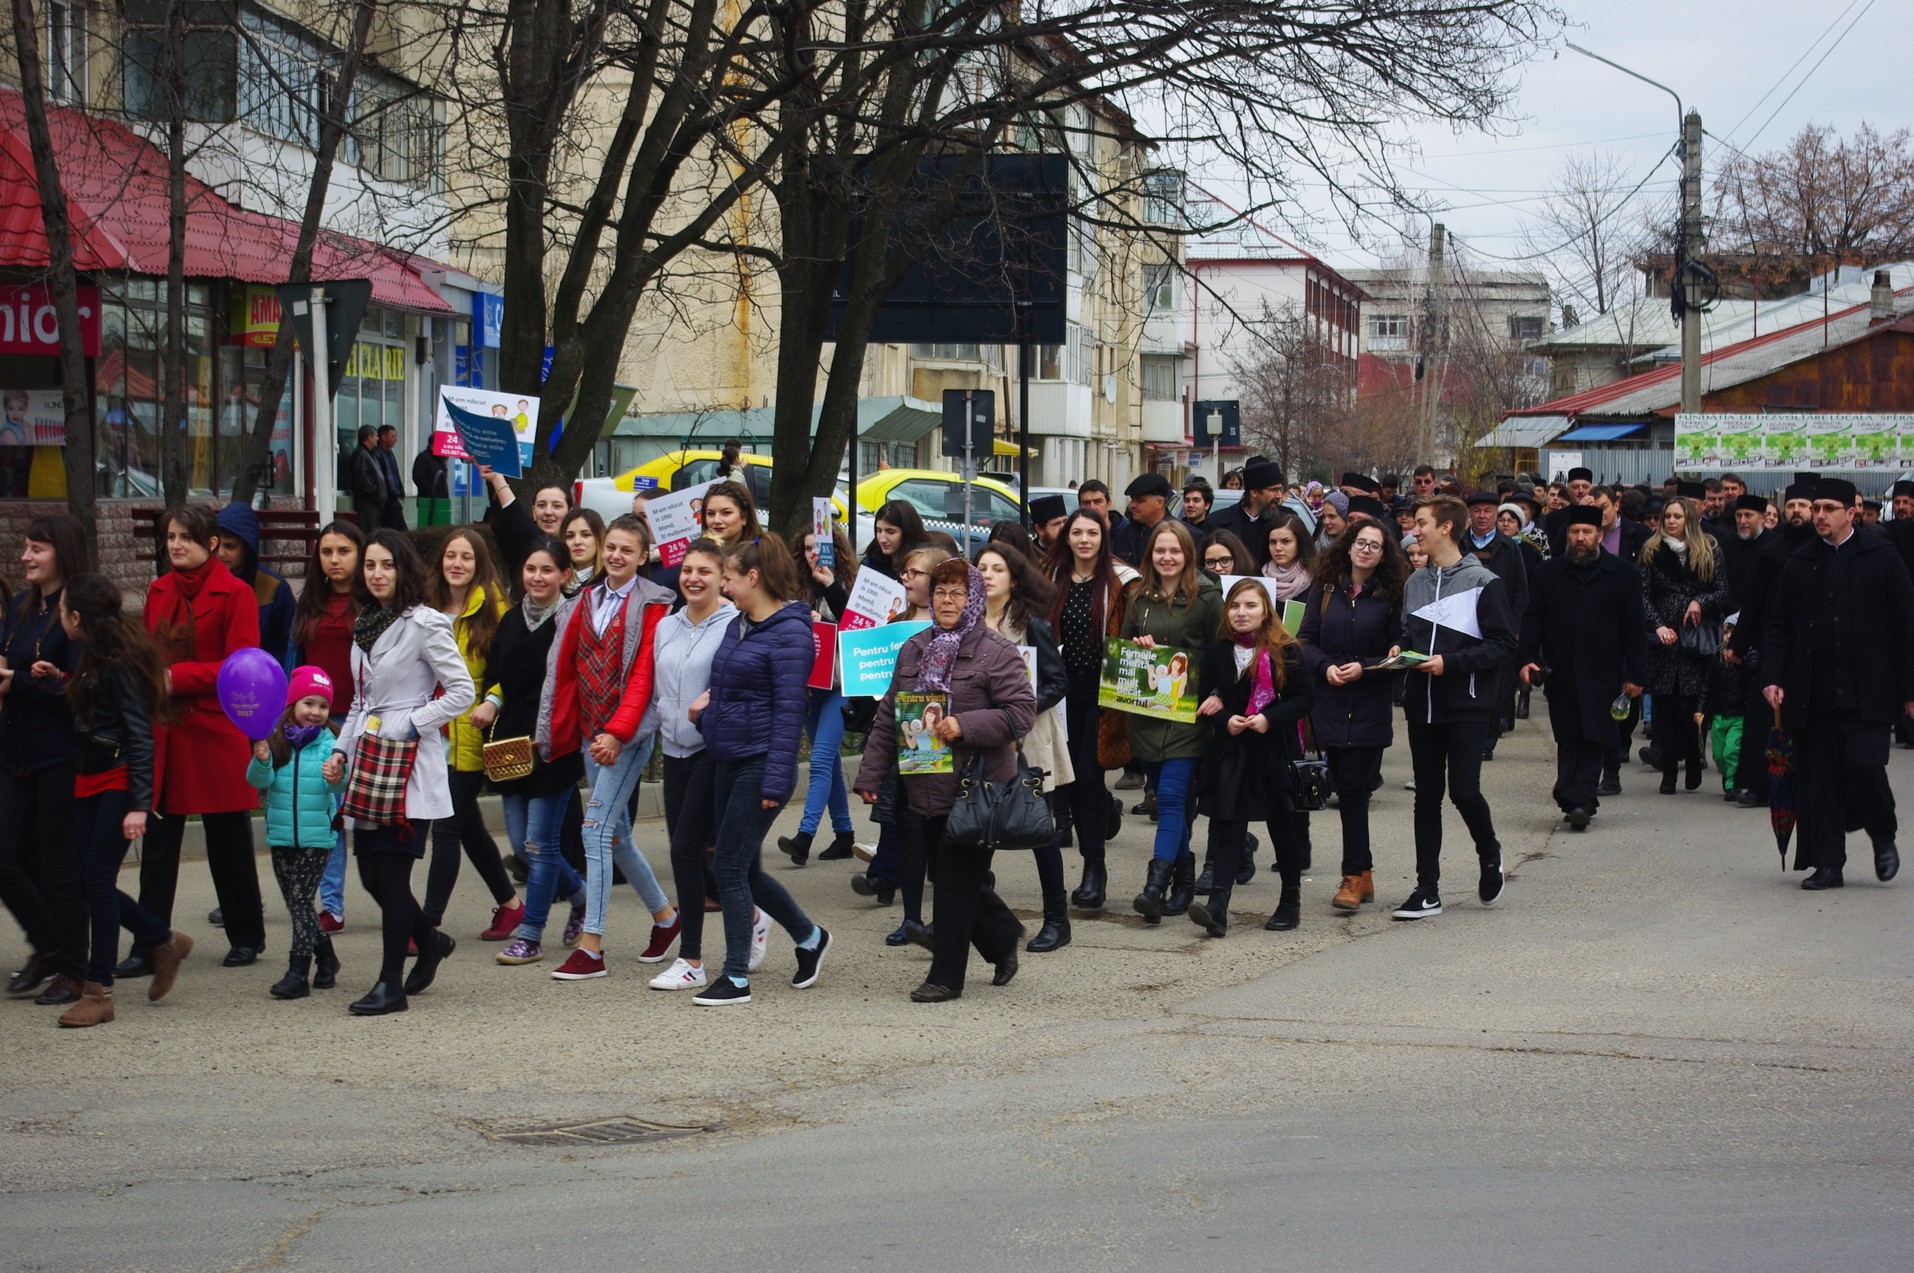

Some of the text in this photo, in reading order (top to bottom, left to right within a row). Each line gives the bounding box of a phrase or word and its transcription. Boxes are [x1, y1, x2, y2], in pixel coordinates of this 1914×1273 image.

[447, 434, 459, 444] 24
[668, 541, 687, 553] 24 %
[853, 615, 864, 626] 24
[853, 646, 888, 656] Pentru
[1121, 647, 1157, 661] Femeile
[859, 657, 894, 671] pentru
[1120, 658, 1150, 670] merită
[1119, 667, 1136, 676] mai
[1118, 676, 1139, 687] mult
[1116, 685, 1142, 697] decât
[897, 693, 925, 703] Pentru
[1116, 695, 1148, 708] avortul
